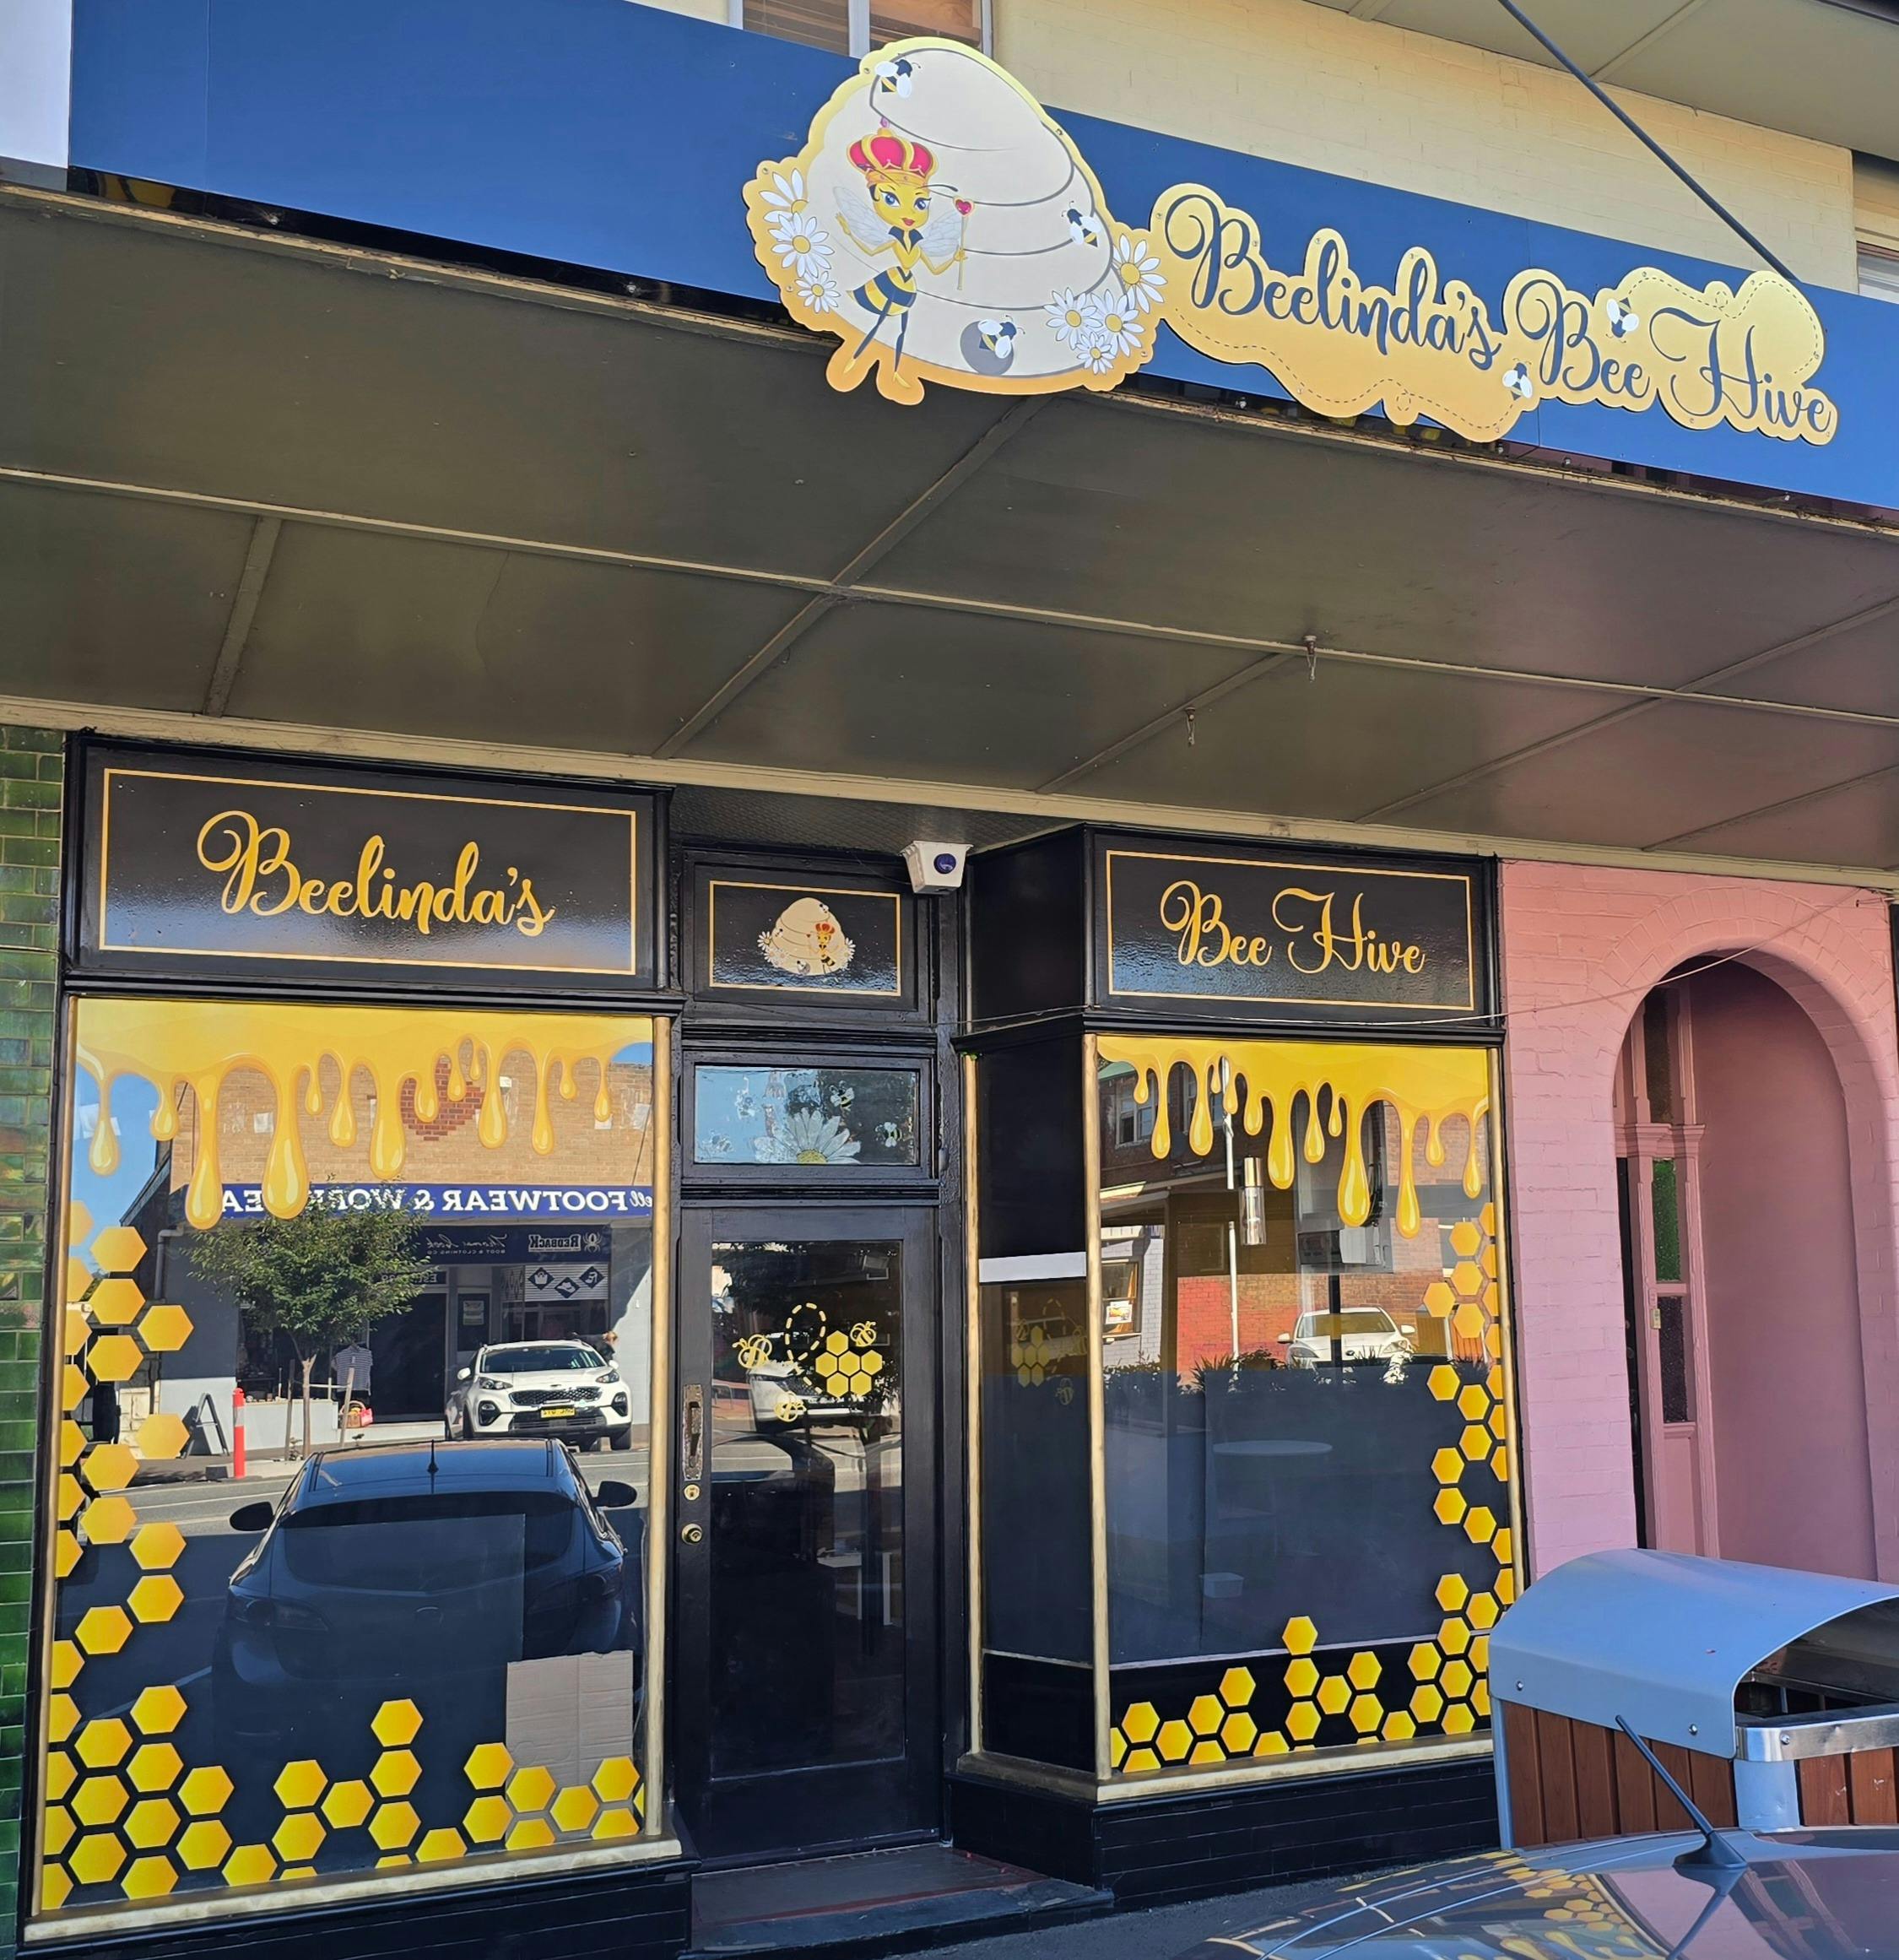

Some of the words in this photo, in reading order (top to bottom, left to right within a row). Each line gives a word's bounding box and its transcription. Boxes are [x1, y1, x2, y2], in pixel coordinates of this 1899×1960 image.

[1164, 193, 1502, 371] Beelinda's
[1516, 279, 1651, 398] Bee
[1649, 306, 1831, 433] Hive
[197, 810, 556, 937] Beelinda's
[1160, 880, 1274, 967] Bee
[1272, 887, 1426, 975] Hive
